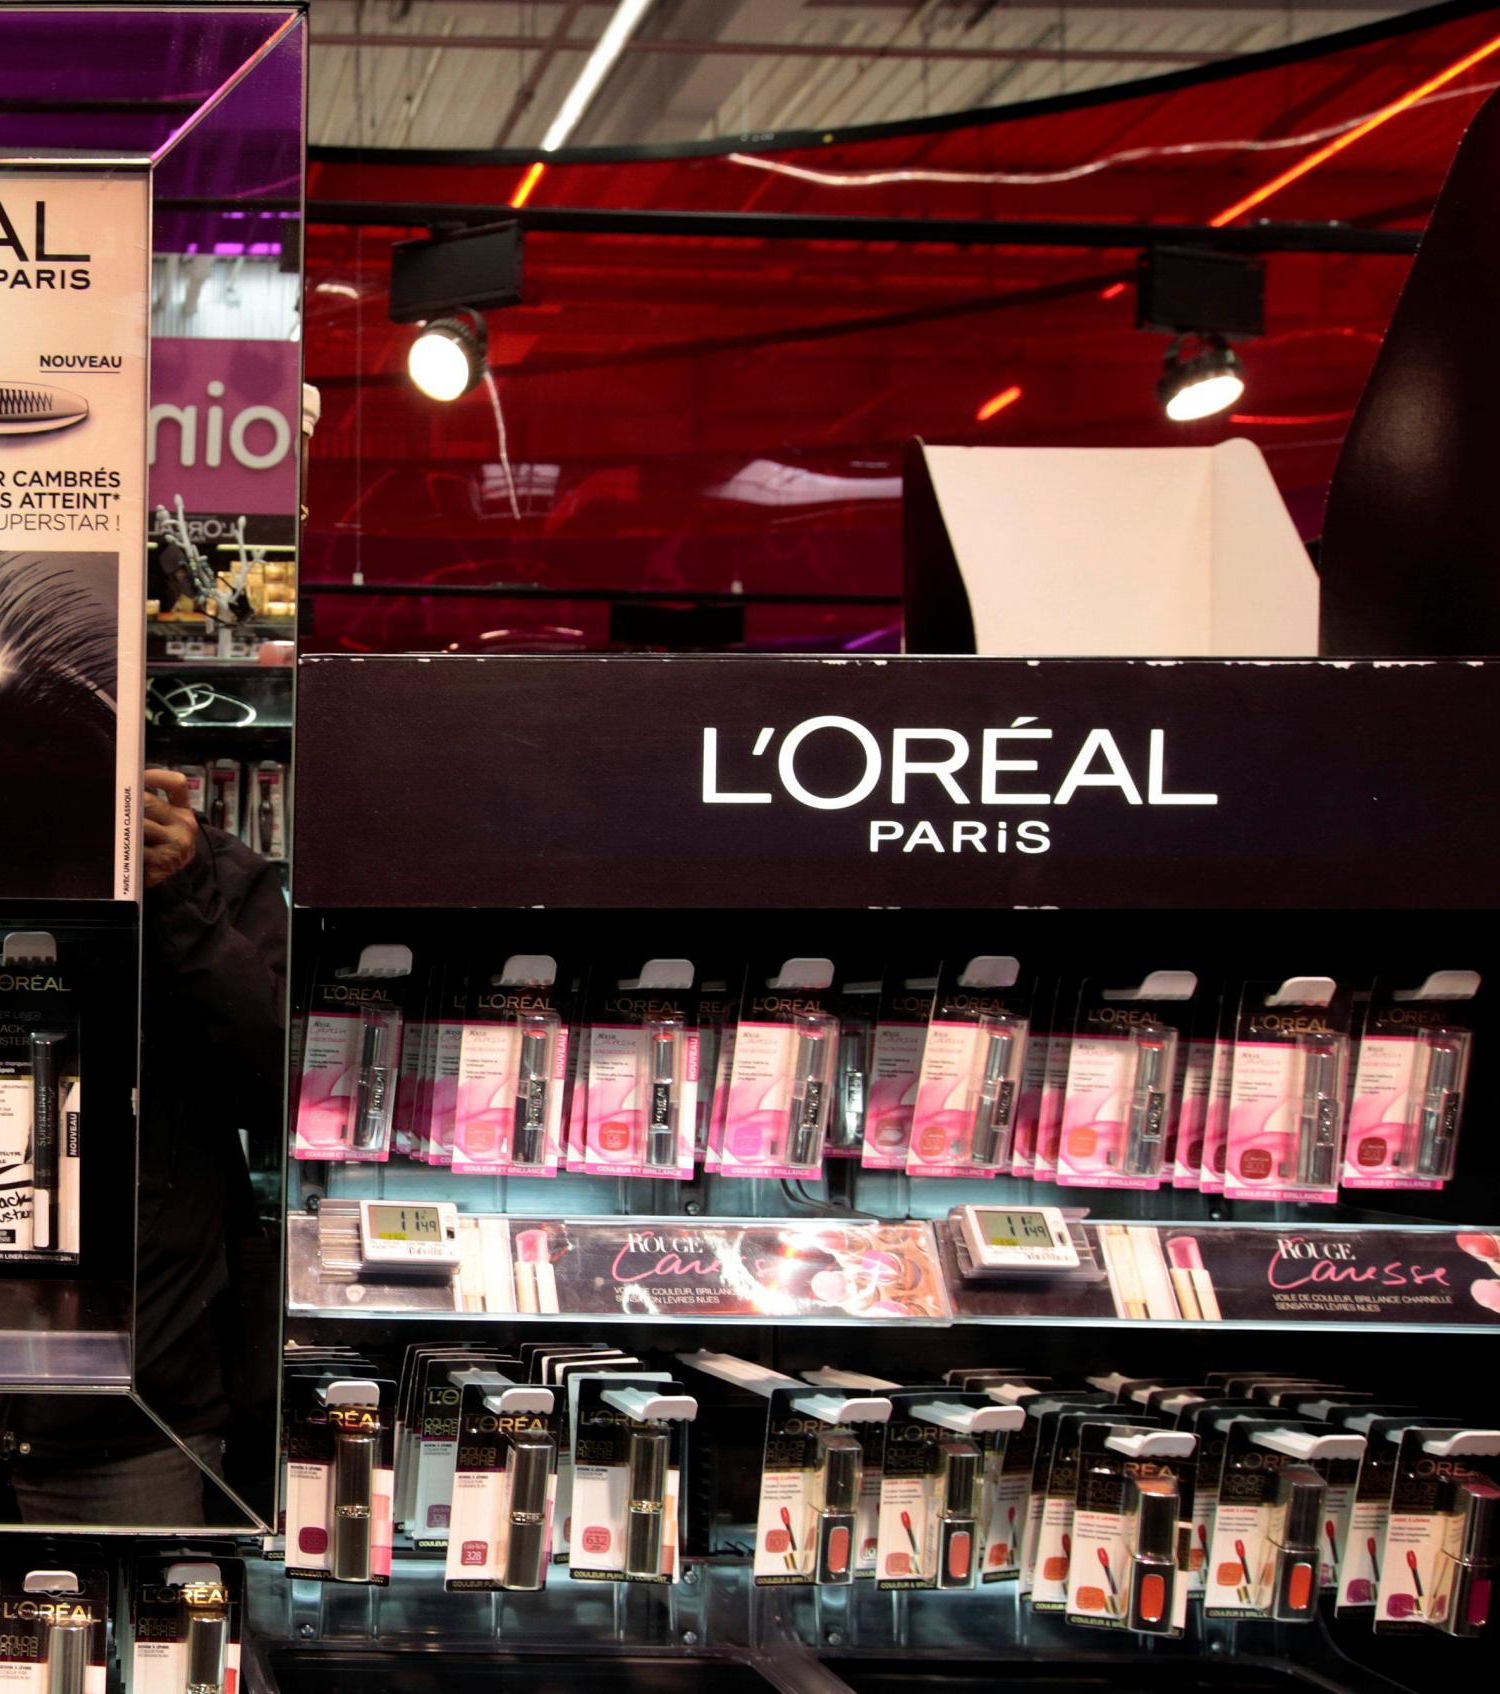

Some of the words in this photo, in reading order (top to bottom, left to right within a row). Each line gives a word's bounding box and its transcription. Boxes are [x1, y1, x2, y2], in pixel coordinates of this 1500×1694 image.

[39, 354, 123, 369] NOUVEAU
[13, 466, 121, 488] CAMBRÉS
[702, 716, 1218, 810] L'ORÉAL
[555, 1036, 566, 1078] NOUVEAU
[689, 1037, 698, 1081] NOUVEAU
[70, 1113, 78, 1156] NOUVEAU
[629, 1232, 704, 1254] ROUGE
[1277, 1239, 1356, 1260] ROUGE
[1268, 1237, 1450, 1290] Caresse
[1276, 1302, 1324, 1311] SENSATION
[1357, 1304, 1381, 1312] NUES
[1354, 1296, 1401, 1304] BRILLANCE
[1403, 1296, 1453, 1305] CHARNELLE
[459, 1447, 496, 1457] COLOR
[459, 1456, 495, 1466] RICHE
[586, 1536, 608, 1546] 632
[466, 1551, 482, 1560] 328
[3, 1600, 102, 1623] L'ORÉAL
[0, 1635, 39, 1646] COLOR
[0, 1646, 38, 1657] RICHE
